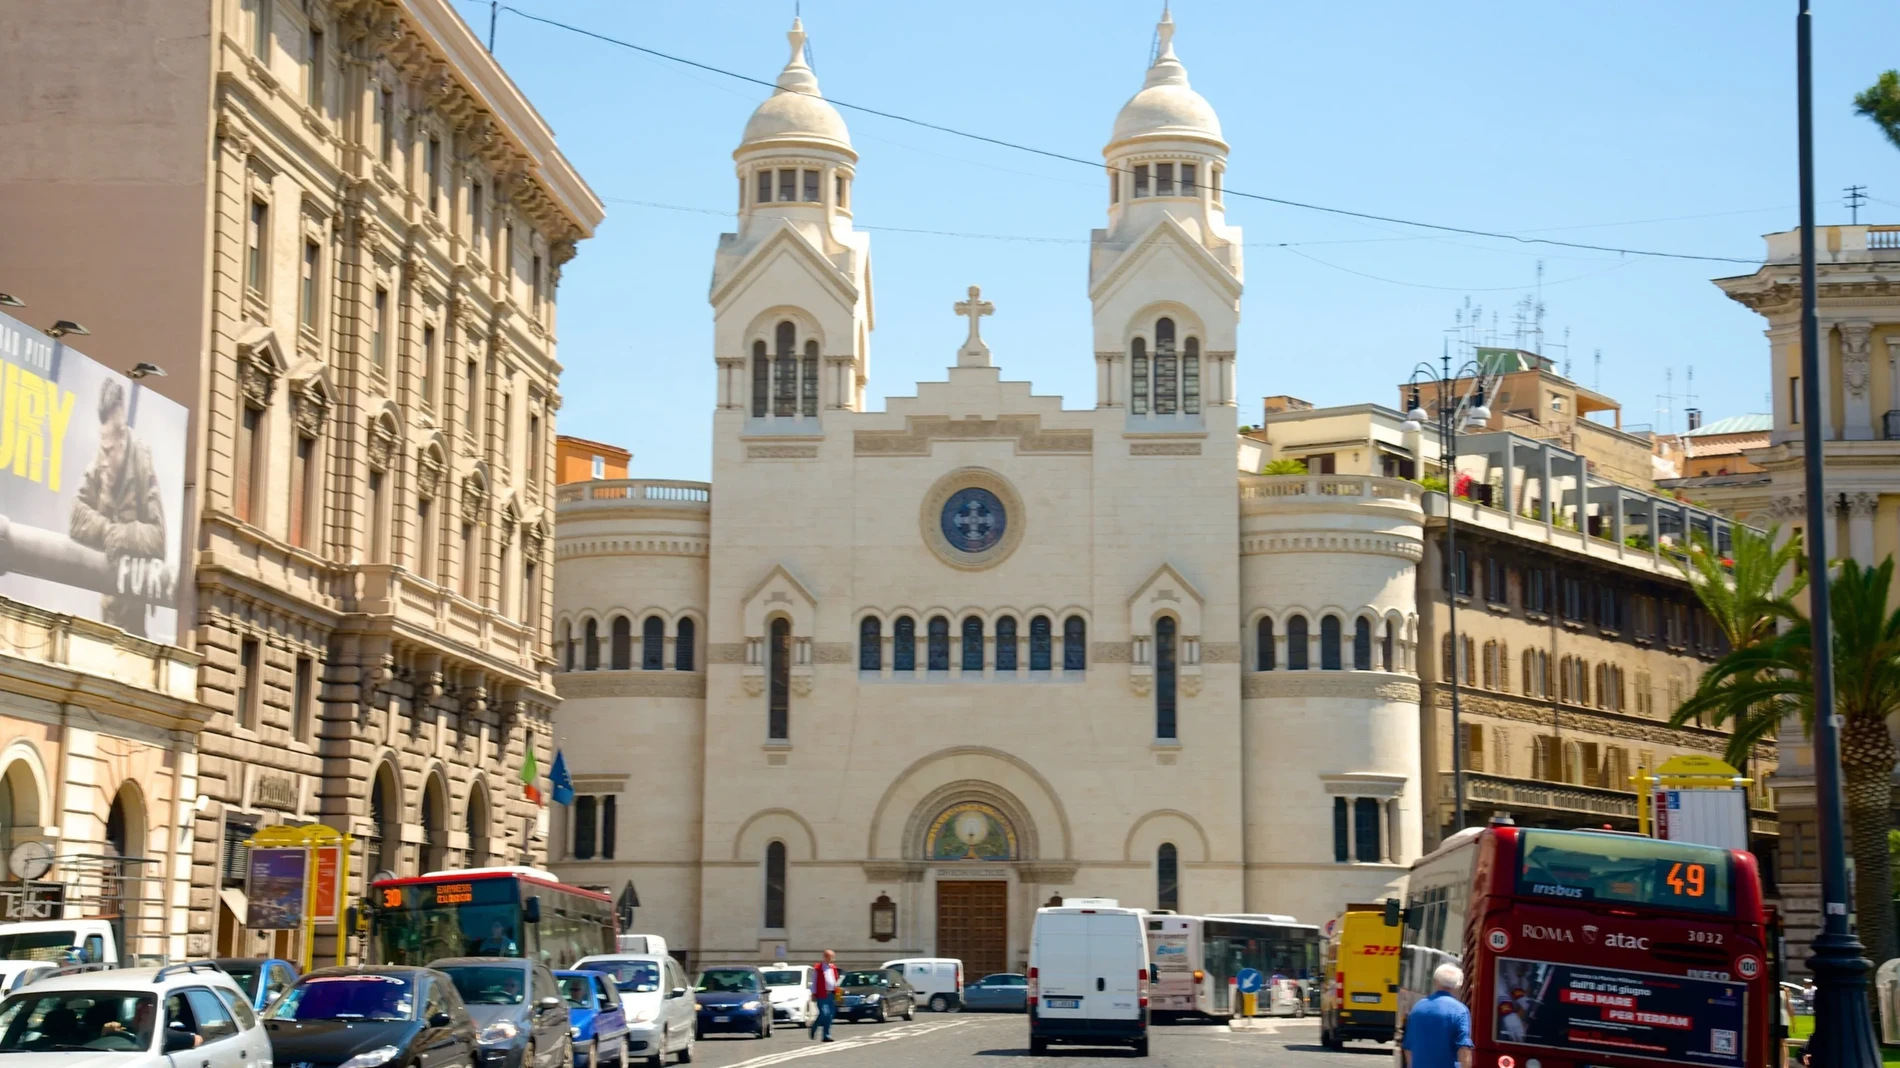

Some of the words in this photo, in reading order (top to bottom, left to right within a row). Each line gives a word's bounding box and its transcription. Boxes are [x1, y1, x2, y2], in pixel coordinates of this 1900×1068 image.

[1666, 863, 1705, 897] 49
[383, 888, 401, 908] 30
[1522, 924, 1575, 943] ROMA
[1604, 932, 1650, 950] atac
[1688, 930, 1724, 945] 3032
[1363, 945, 1401, 956] DH
[1569, 991, 1595, 1003] PER
[1596, 994, 1633, 1007] MARE
[1618, 985, 1652, 996] giugno
[1609, 1009, 1635, 1021] PER
[1636, 1012, 1689, 1027] TERRAM
